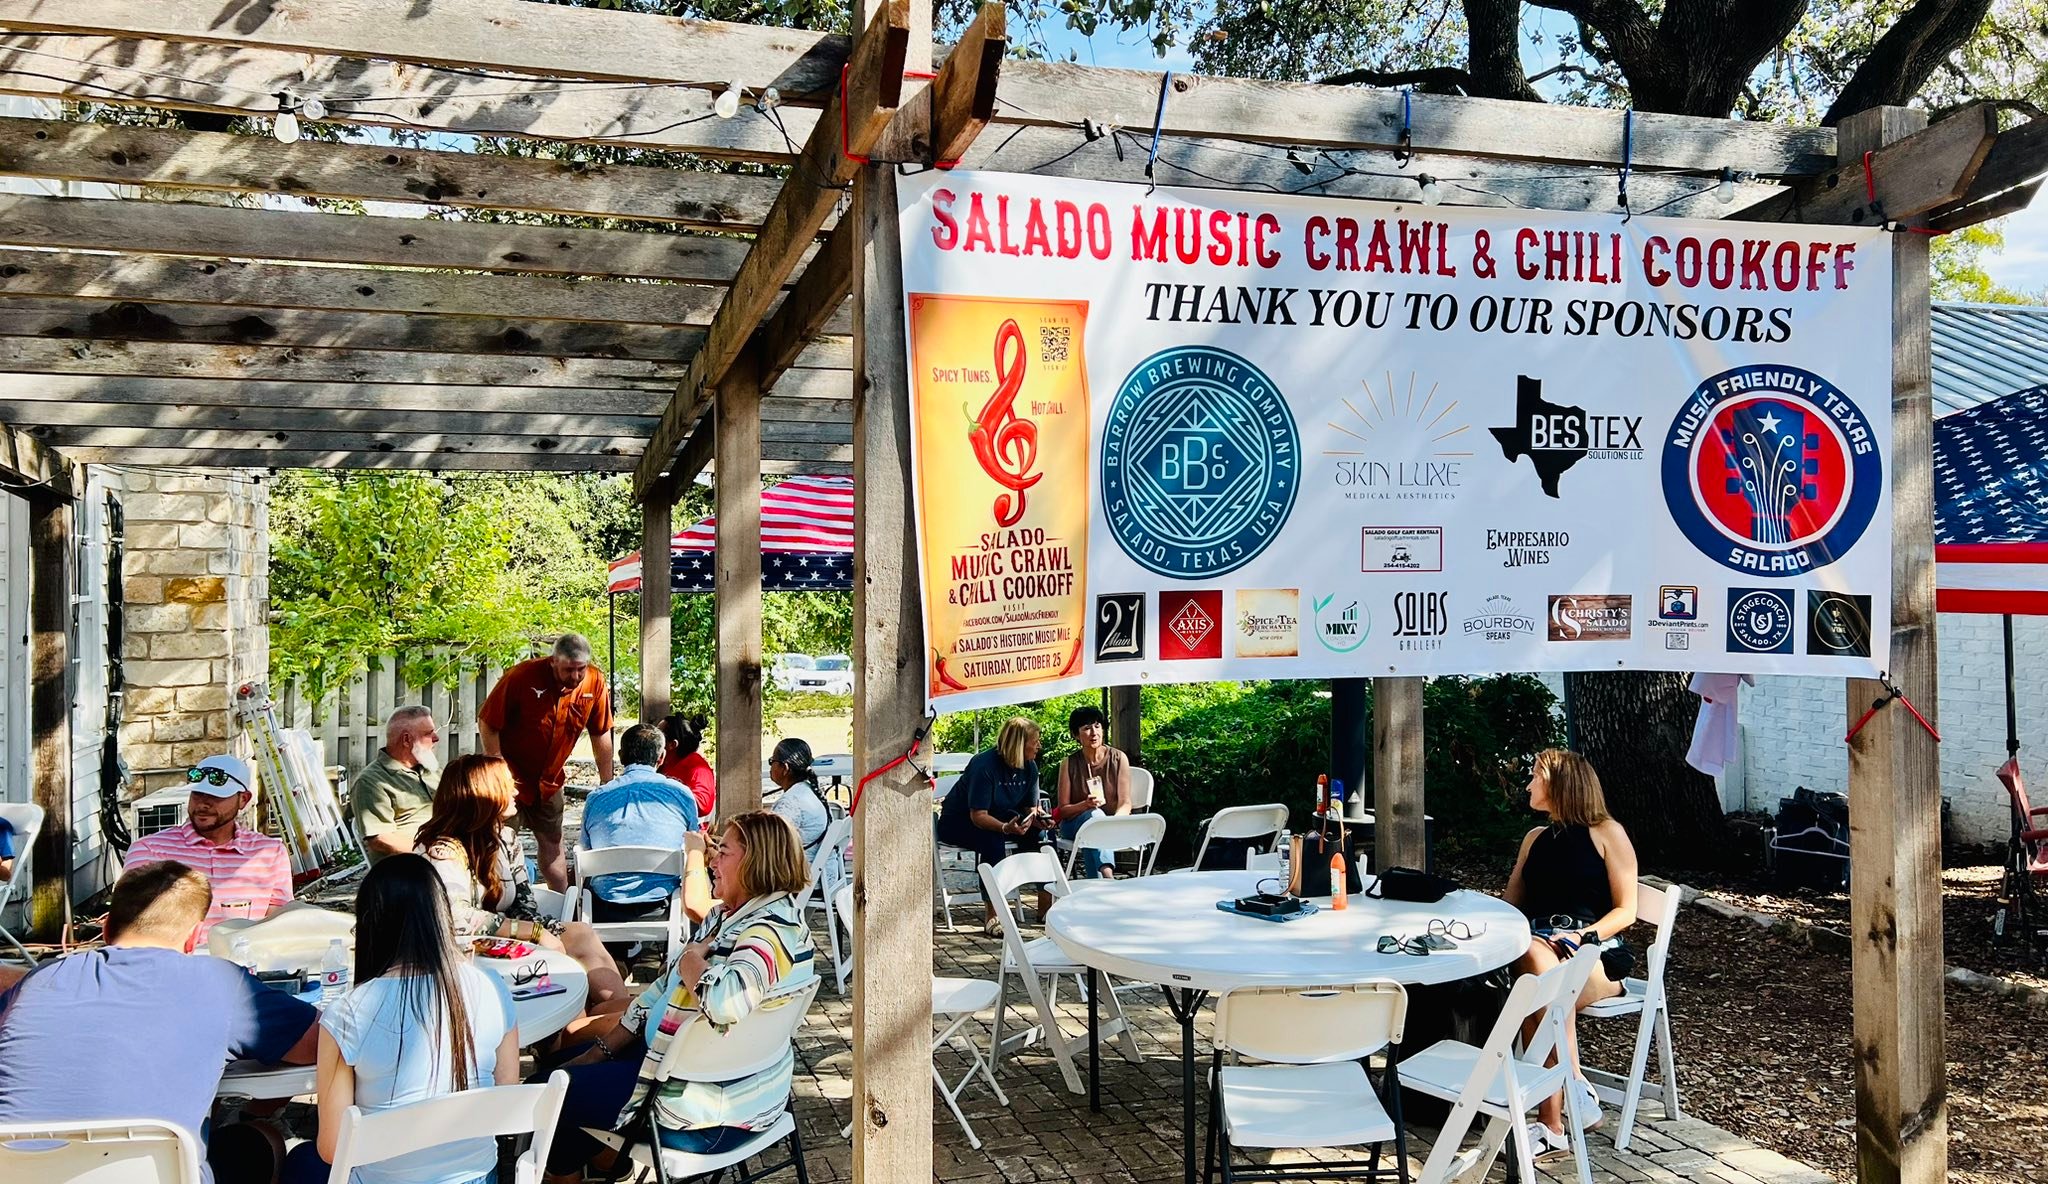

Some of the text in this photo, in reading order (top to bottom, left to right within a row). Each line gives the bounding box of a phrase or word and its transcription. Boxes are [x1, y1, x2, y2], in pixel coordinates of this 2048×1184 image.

[930, 187, 1857, 291] SALADO MUSIC CRAWL & CHILI COOKOFF
[1145, 282, 1793, 343] THANK YOU TO OUR SPONSORS
[932, 367, 959, 383] SPICY
[1106, 356, 1292, 470] BARROW BREWING COMPANY
[1672, 370, 1874, 457] MUSIC FRIENDLY TEXAS
[1588, 450, 1644, 461] SOLUTIONS LLC
[1335, 461, 1462, 487] SKIN LUXE
[1345, 492, 1456, 500] MEDICAL AESTHETICS
[981, 527, 1045, 552] SALADO
[1110, 498, 1284, 569] SALADO, TEXAS USA
[951, 546, 1073, 581] MUSIC CRAWL
[1728, 547, 1811, 572] SALADO
[948, 588, 958, 605] &
[1002, 572, 1074, 601] COOKOFF
[1247, 615, 1275, 625] SPICE
[1277, 614, 1298, 625] TEA
[1392, 590, 1448, 637] SOLAS
[1568, 607, 1628, 619] CHRISTY'S
[1736, 597, 1786, 621] STAGECOACH
[1099, 598, 1139, 657] 21
[1177, 619, 1207, 630] AXIS
[1325, 623, 1357, 635] MINT
[1463, 617, 1535, 633] BOURBON
[1586, 618, 1628, 627] SALADO
[1648, 619, 1709, 628] 3DeviantPrints.com
[959, 635, 998, 653] SALADO'S
[1000, 631, 1034, 649] HISTORIC
[1035, 629, 1056, 644] MUSIC
[1057, 627, 1071, 641] MILE
[1399, 639, 1442, 651] GALLERY
[1485, 631, 1511, 640] SPEAKS
[1772, 630, 1783, 640] TX
[1016, 655, 1051, 673] OCTOBER
[1052, 651, 1062, 668] 25
